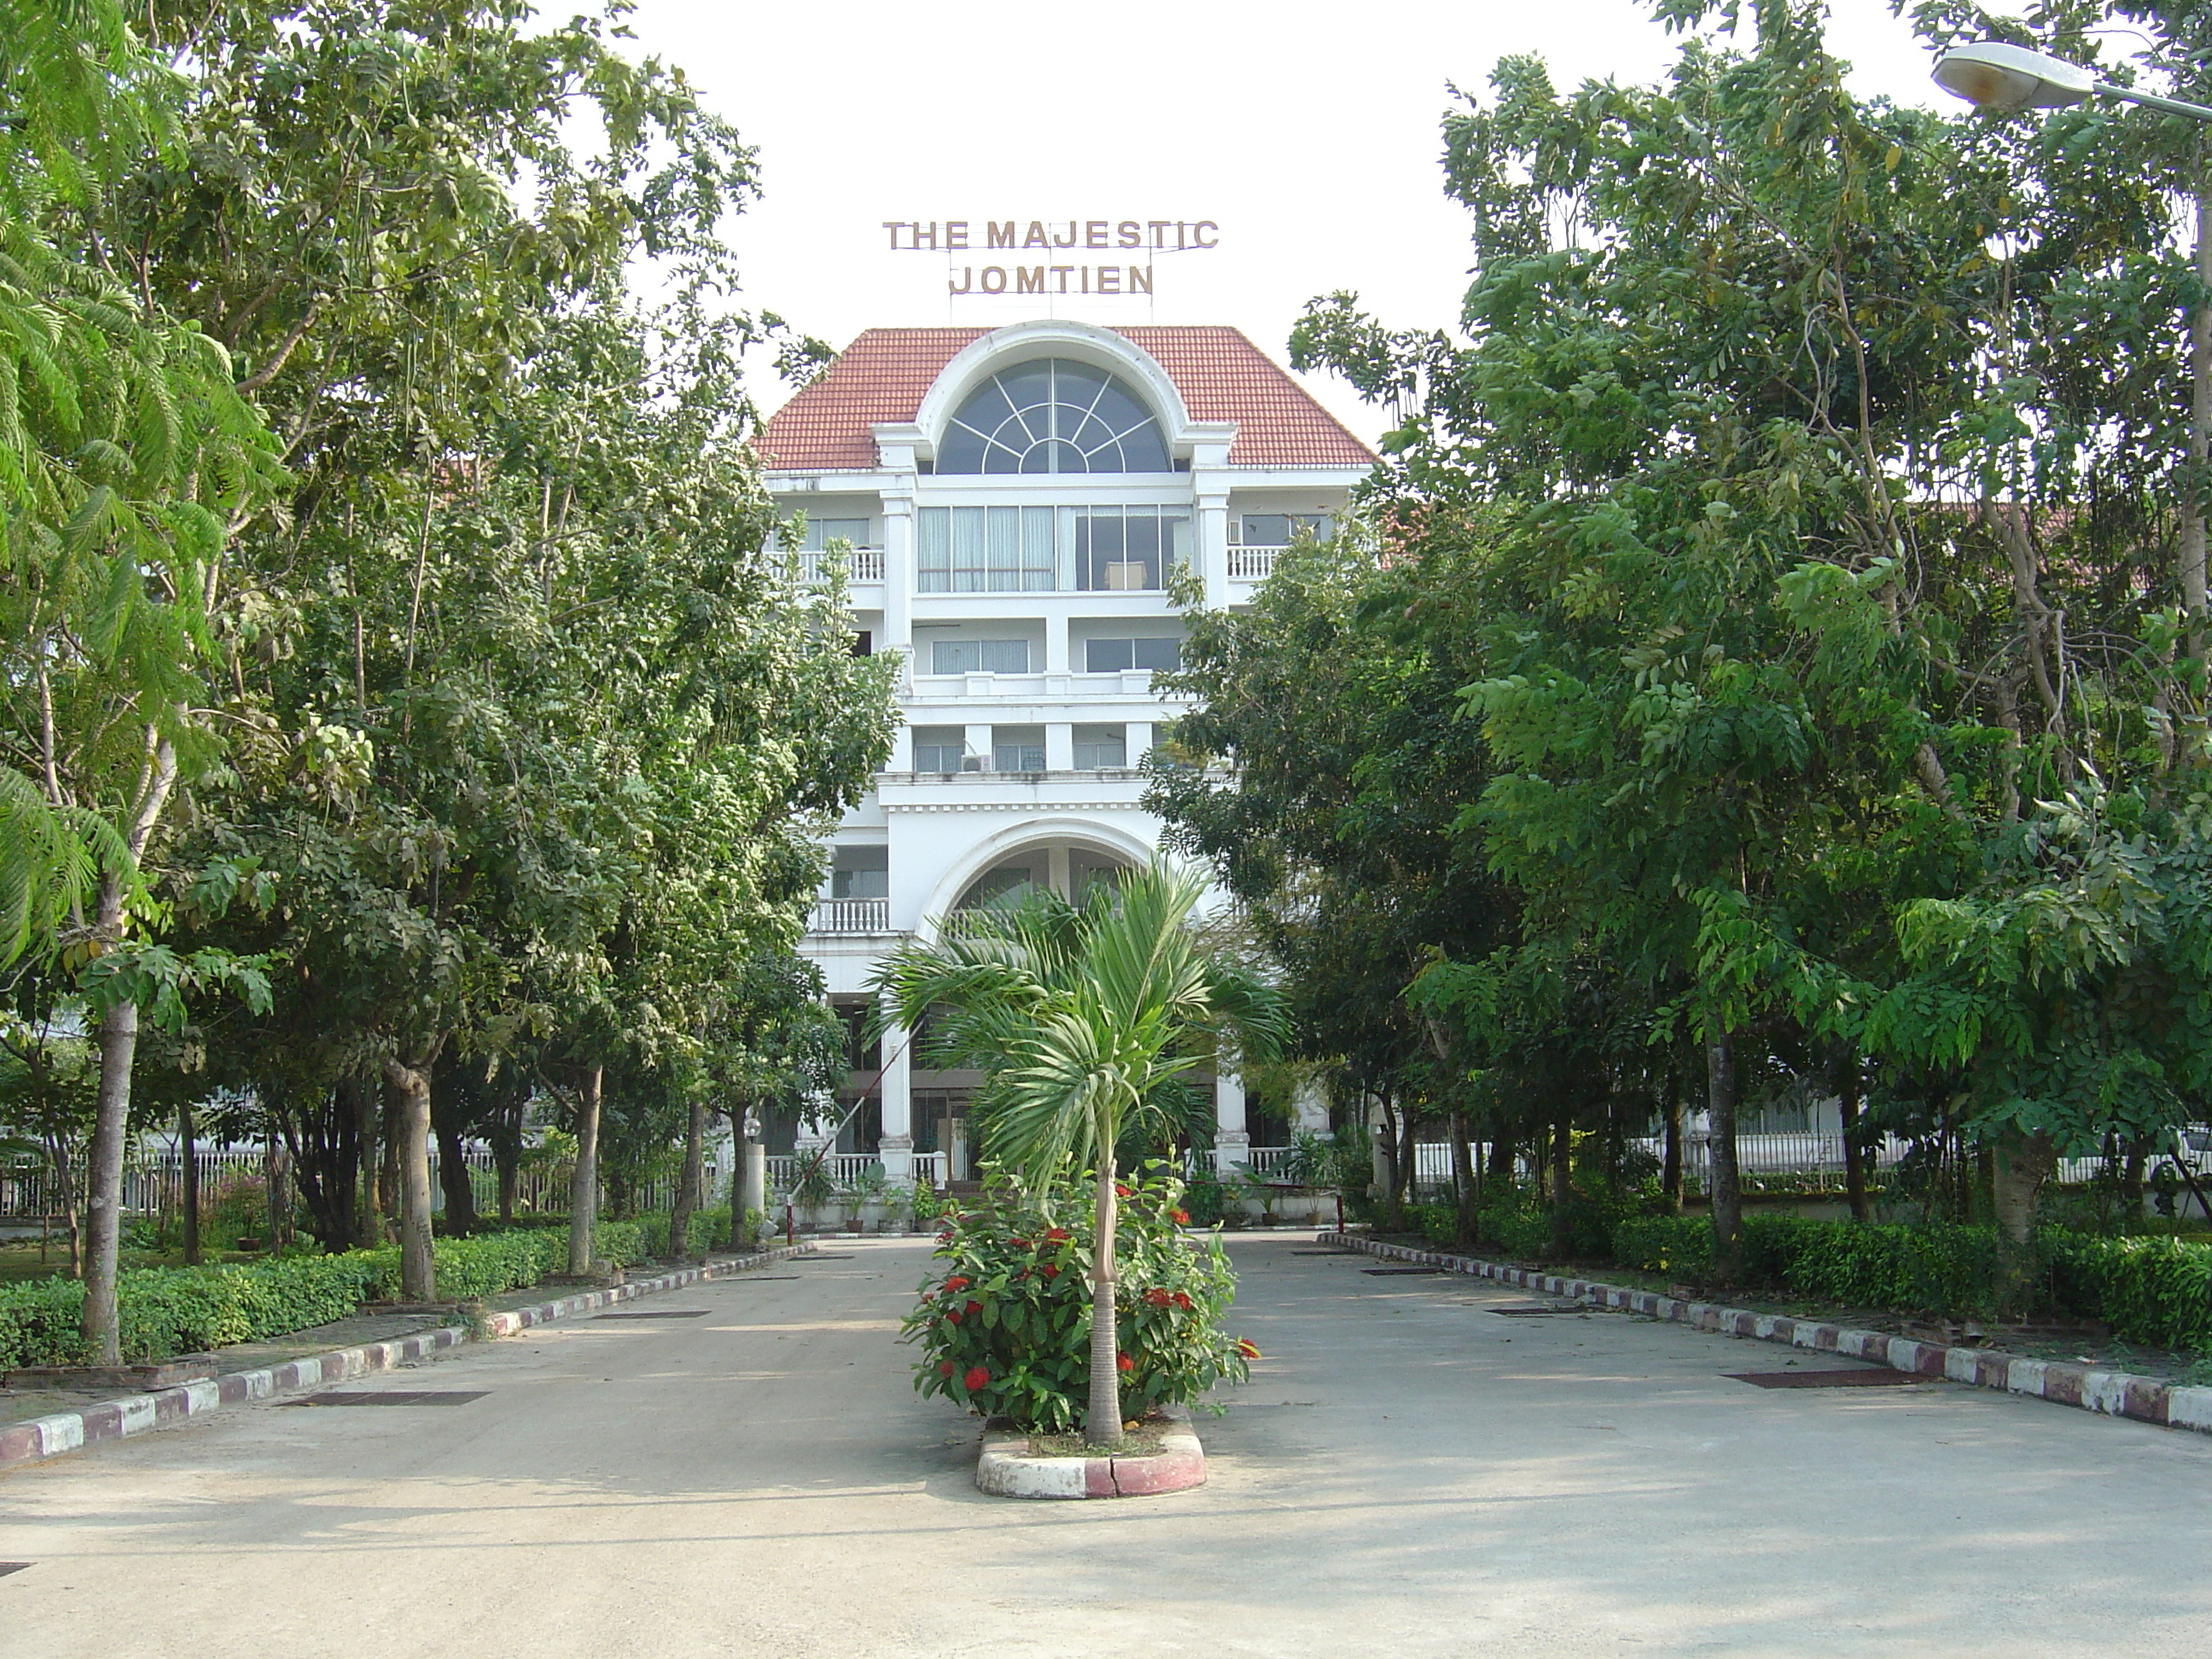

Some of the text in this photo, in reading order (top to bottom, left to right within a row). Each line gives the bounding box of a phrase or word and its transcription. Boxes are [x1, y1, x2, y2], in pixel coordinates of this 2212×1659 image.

[882, 220, 1220, 250] THE MAJESTIC
[948, 265, 1153, 294] JOMTIEN
